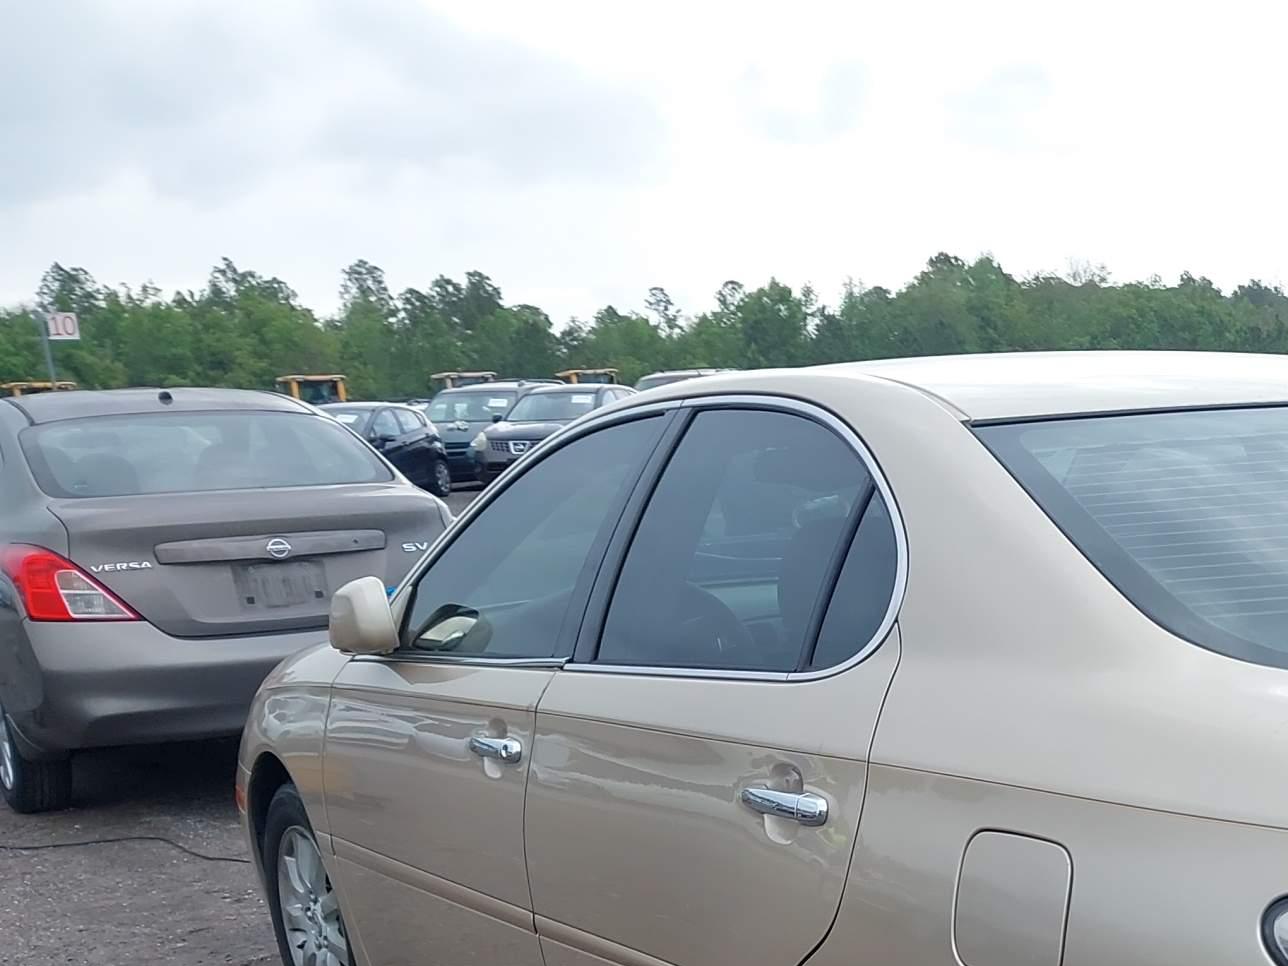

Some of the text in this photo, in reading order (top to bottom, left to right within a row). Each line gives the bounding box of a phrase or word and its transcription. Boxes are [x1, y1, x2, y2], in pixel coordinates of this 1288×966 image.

[49, 315, 76, 336] 10
[400, 541, 429, 553] SV
[90, 561, 153, 573] VERSA
